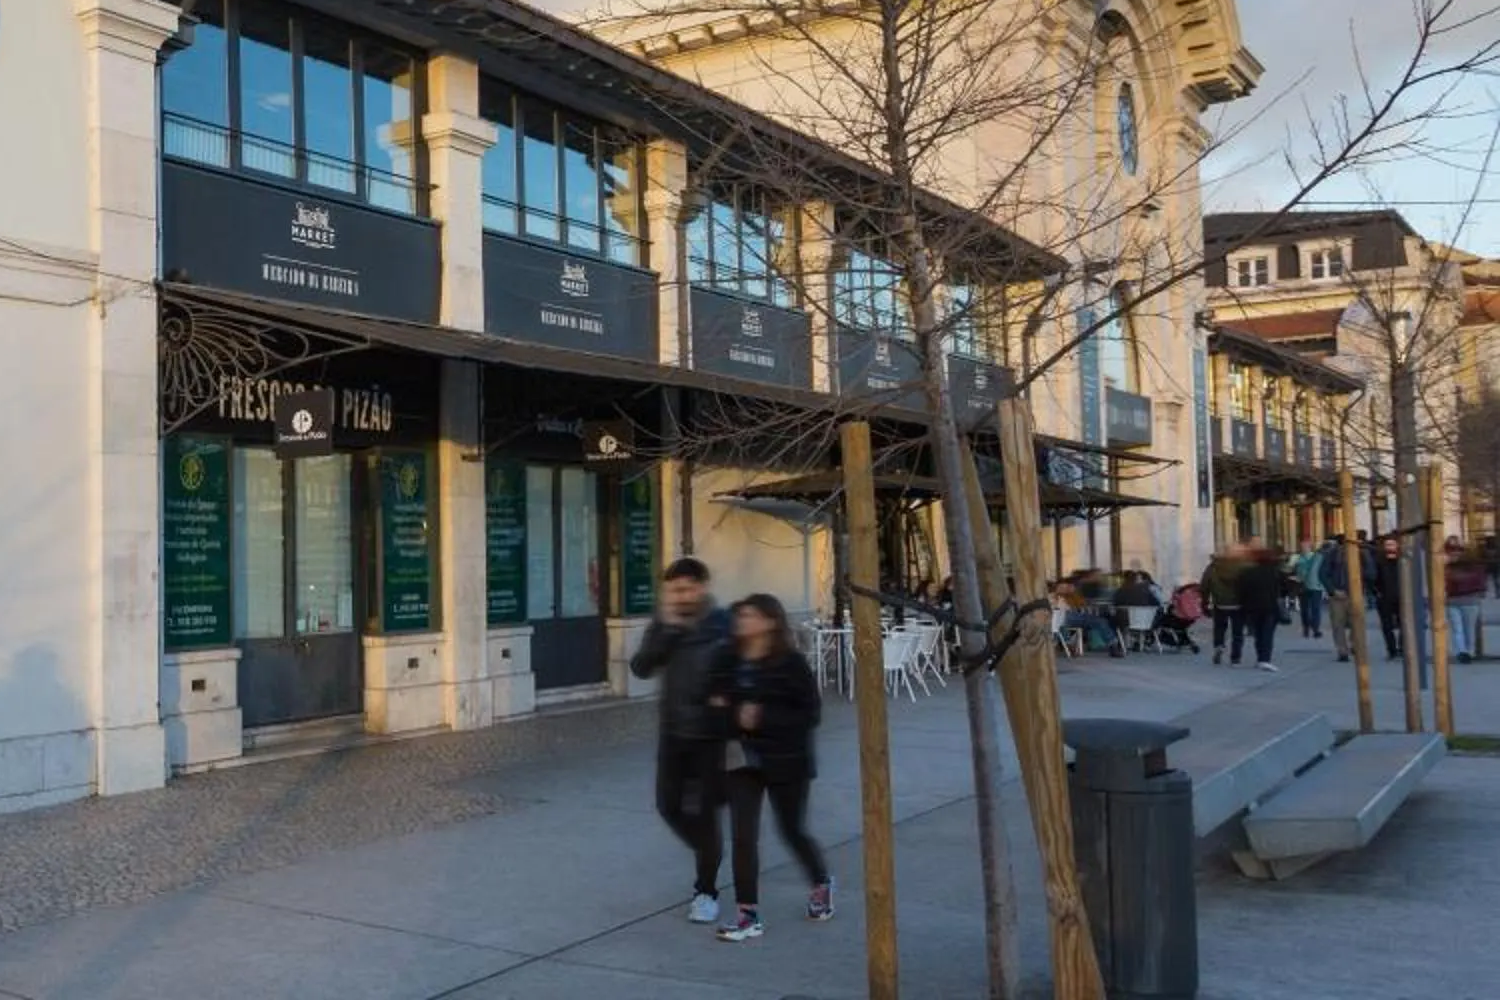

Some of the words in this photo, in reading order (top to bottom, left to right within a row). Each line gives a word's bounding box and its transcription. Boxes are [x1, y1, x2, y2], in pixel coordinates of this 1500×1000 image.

[291, 224, 335, 244] MARKET
[219, 375, 305, 422] FRESC
[342, 384, 392, 432] PIZÃO
